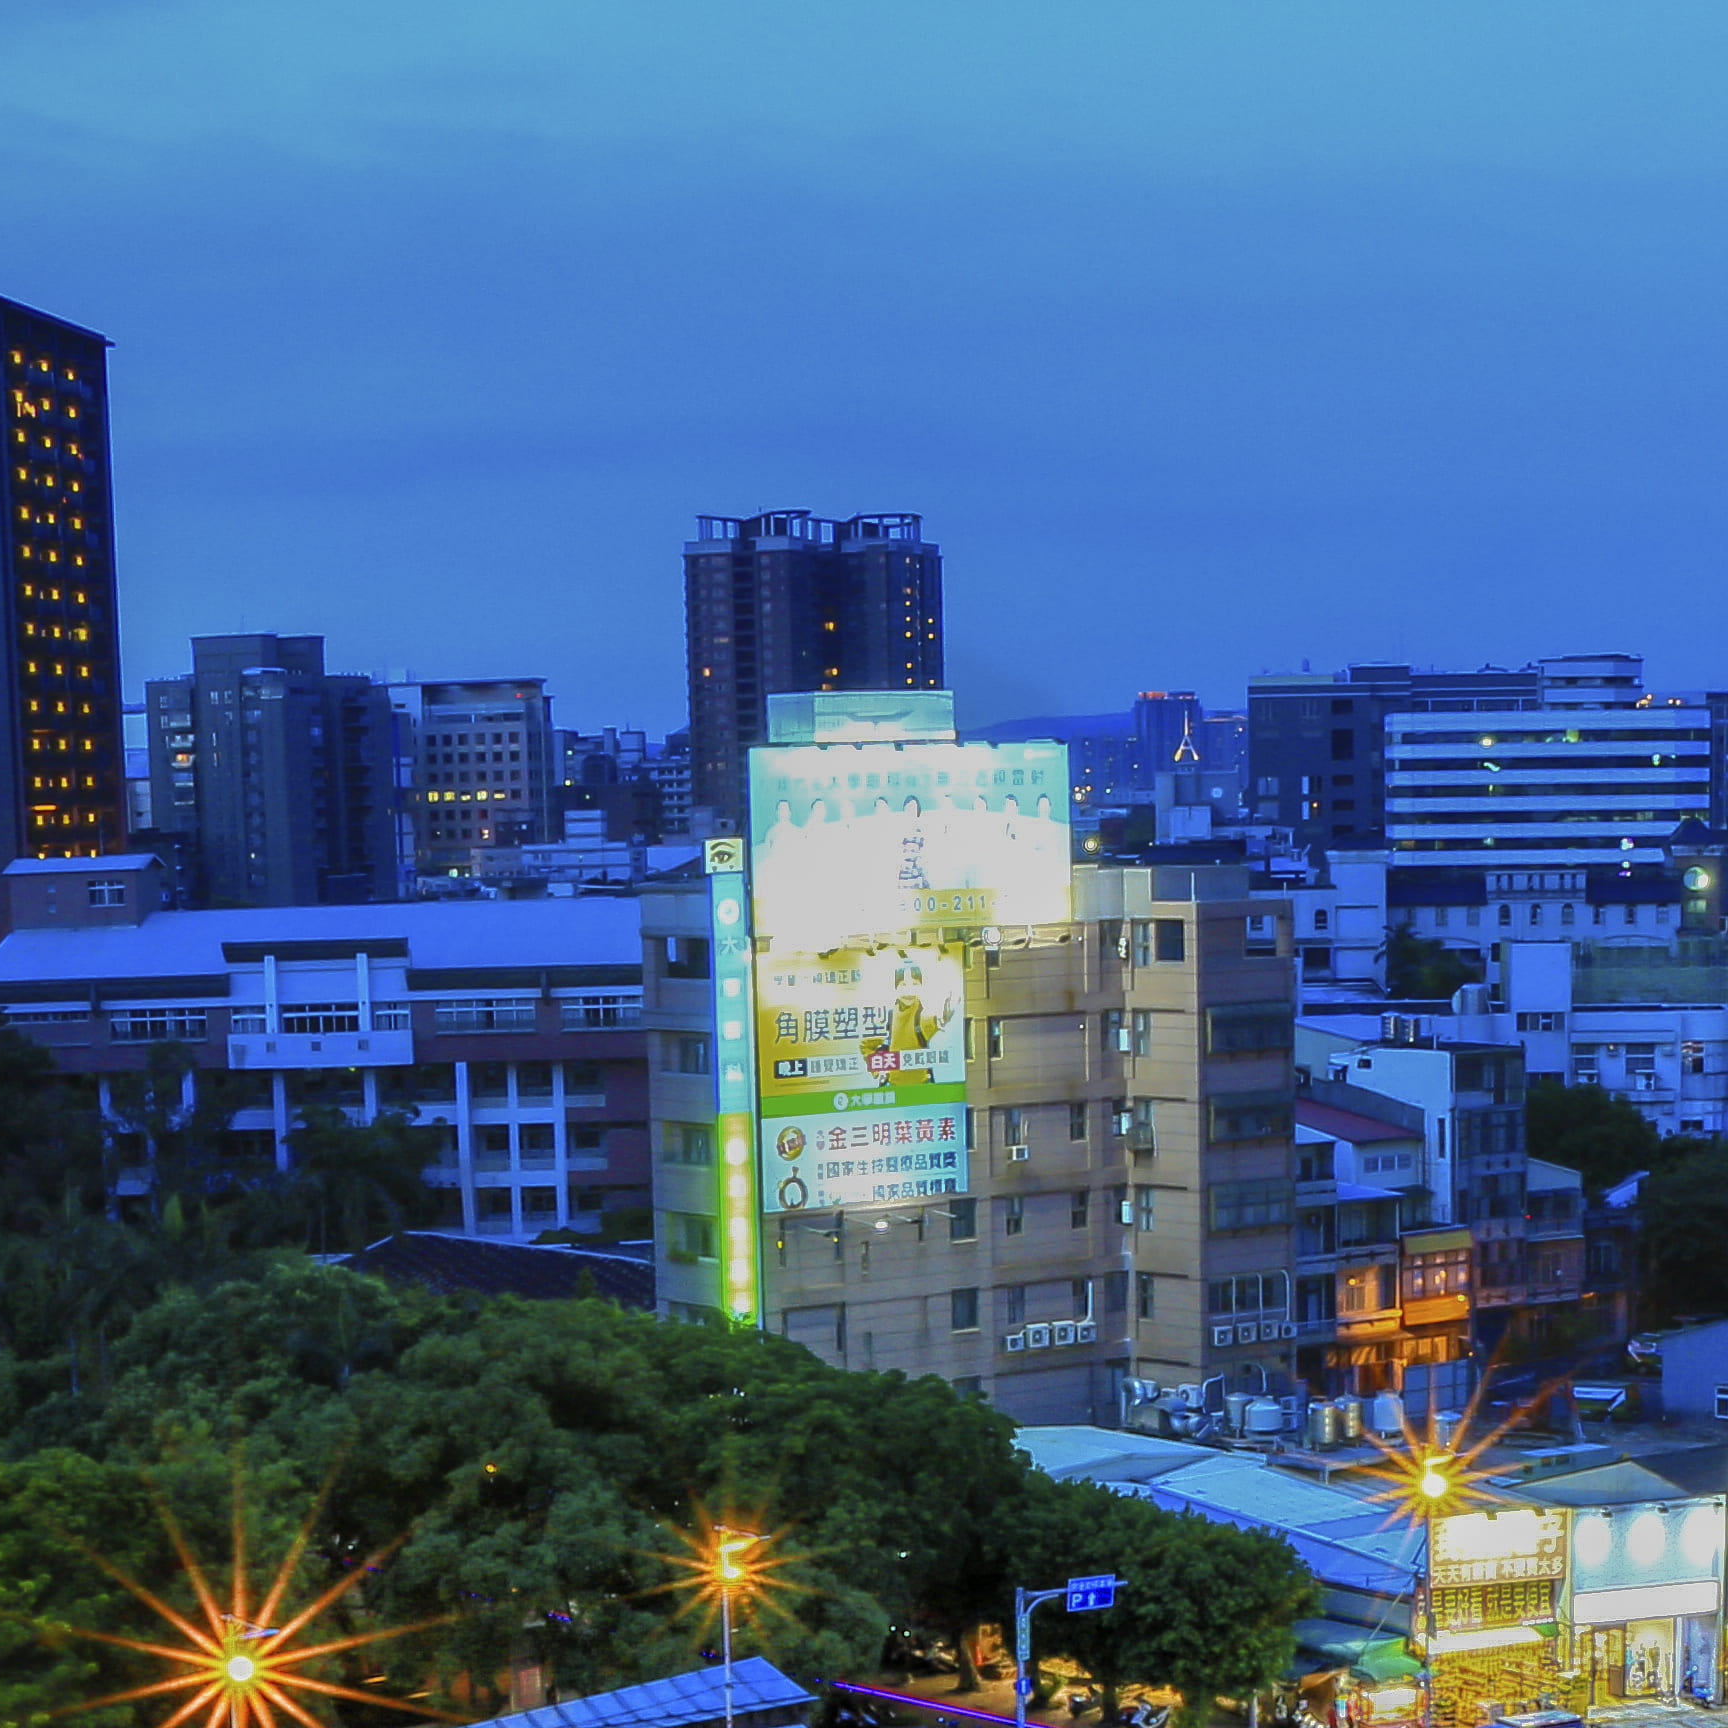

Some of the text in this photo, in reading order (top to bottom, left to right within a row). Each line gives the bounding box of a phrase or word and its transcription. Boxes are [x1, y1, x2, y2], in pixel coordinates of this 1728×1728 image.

[775, 1006, 889, 1044] 角膜塑型
[828, 1117, 956, 1151] 金三明葉黃素
[1072, 1594, 1082, 1608] P
